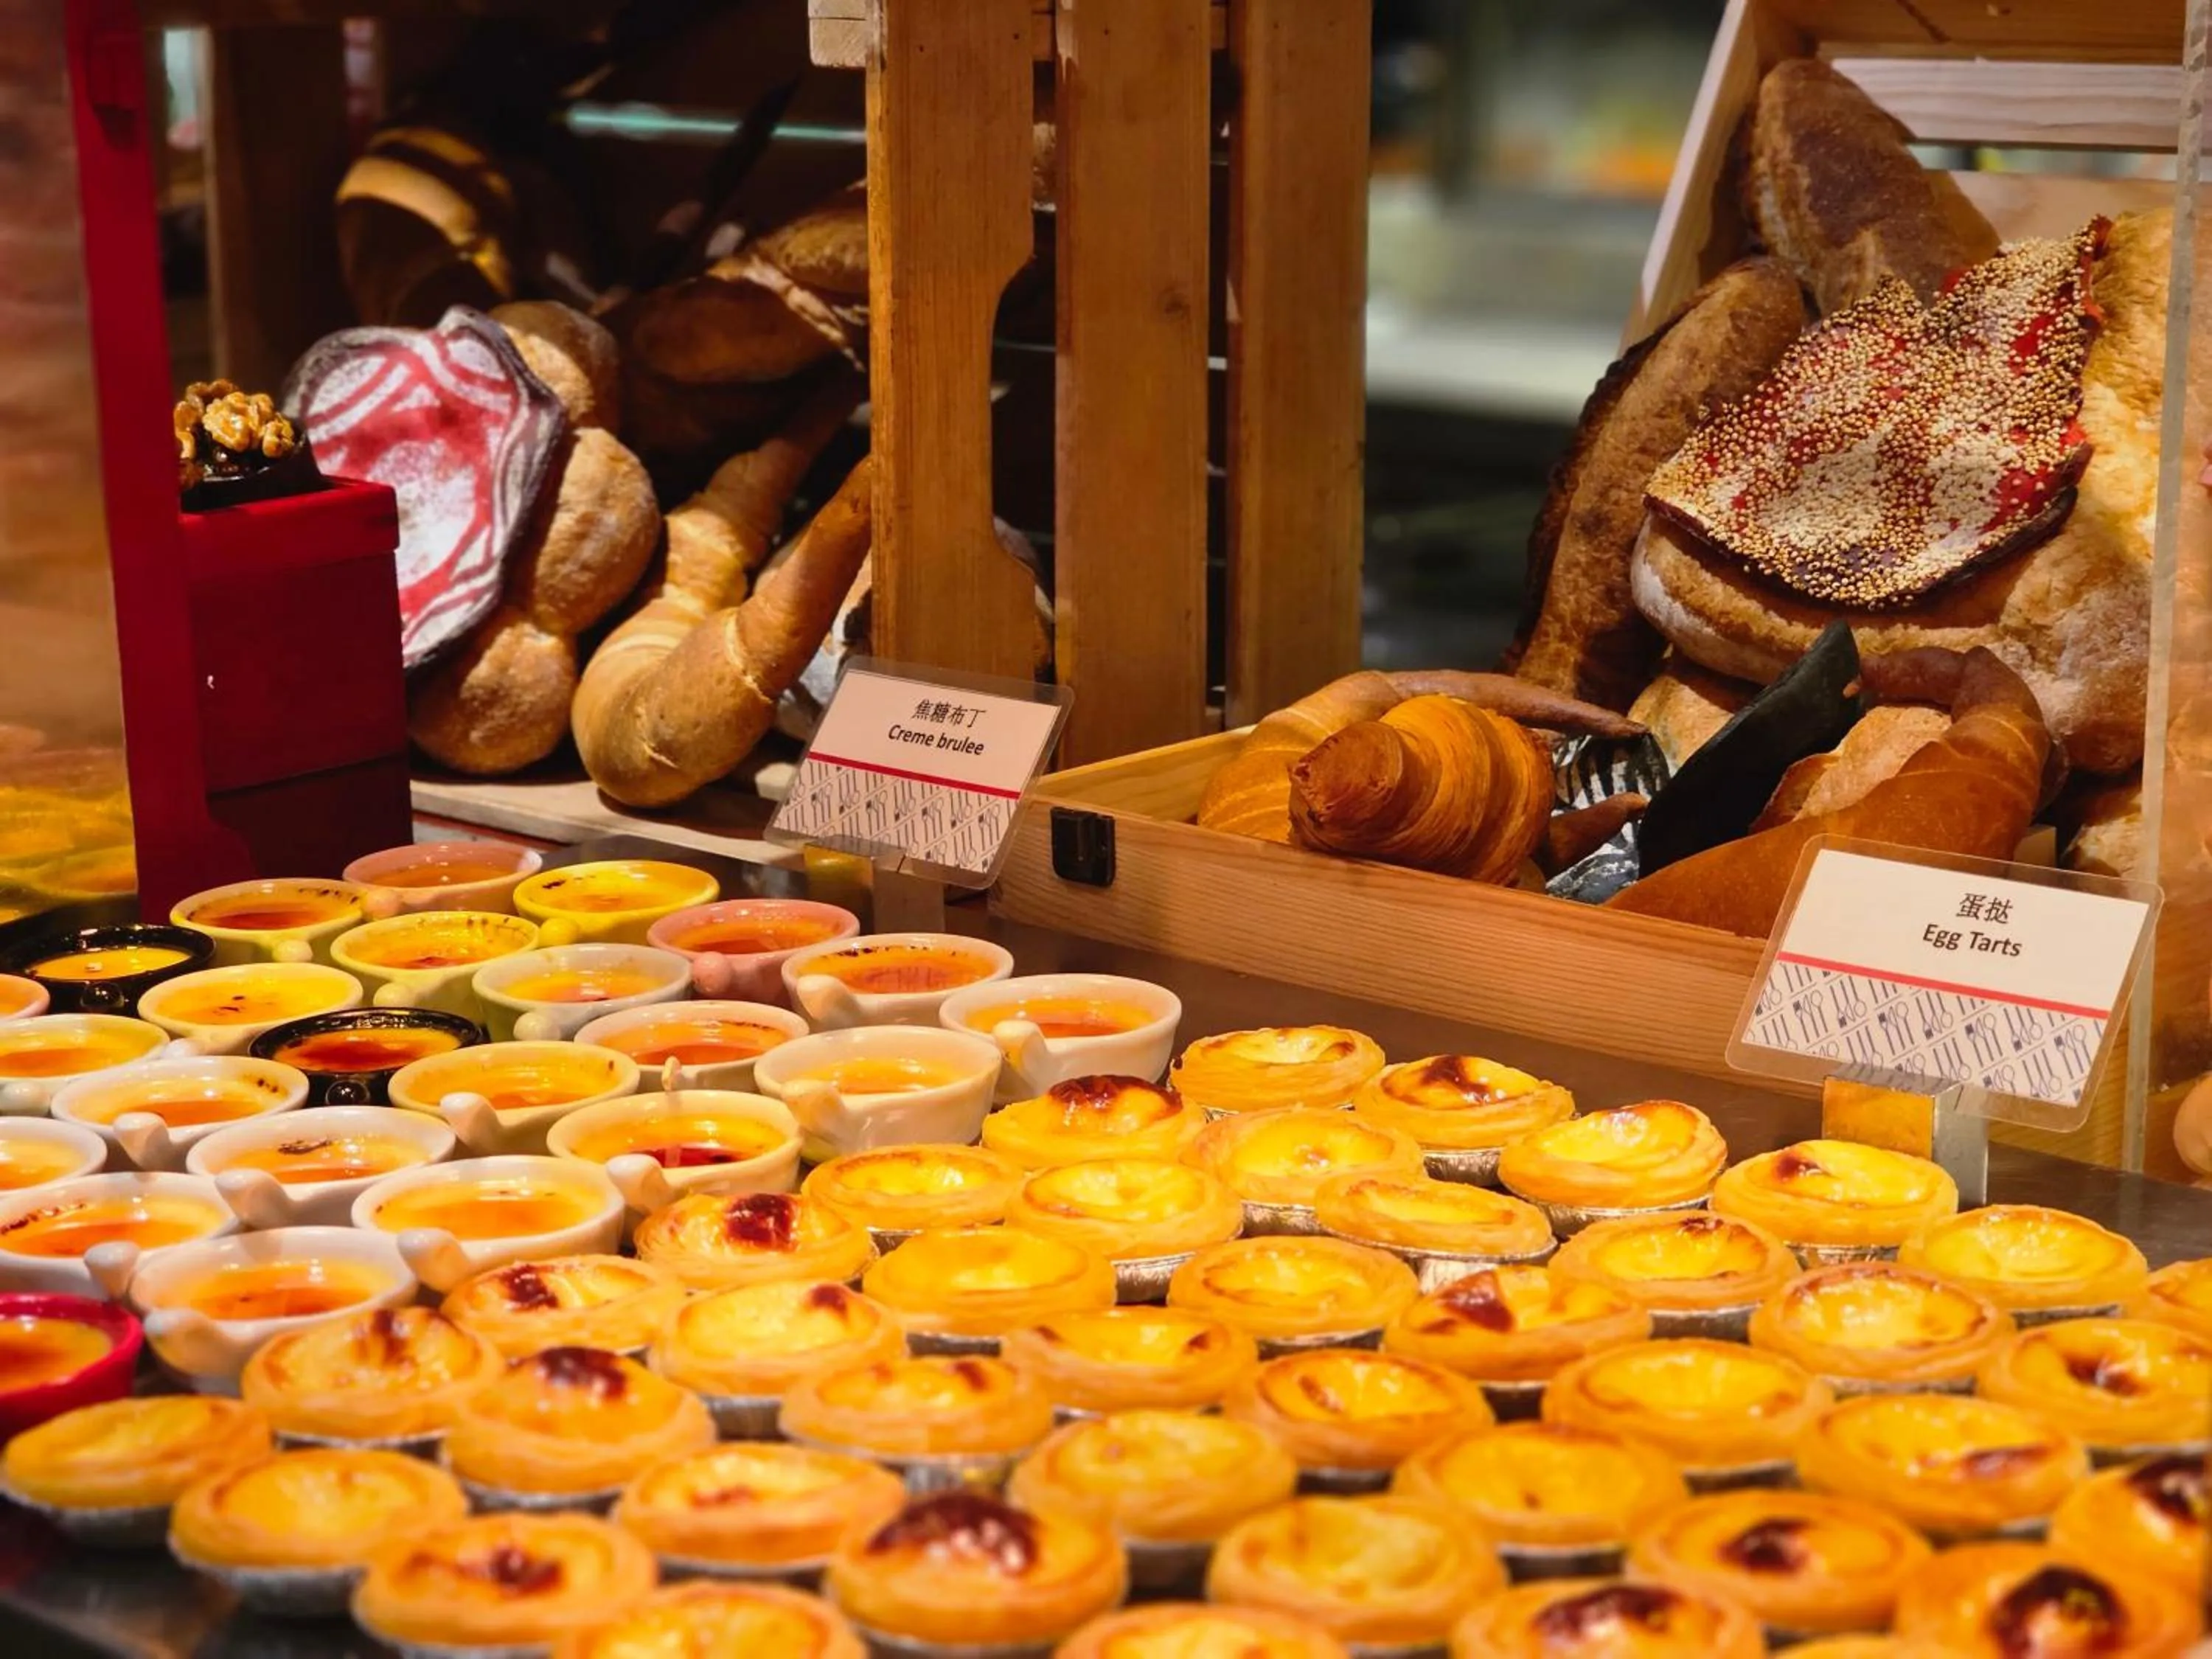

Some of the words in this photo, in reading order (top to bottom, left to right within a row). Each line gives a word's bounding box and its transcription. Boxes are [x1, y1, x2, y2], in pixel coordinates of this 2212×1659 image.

[911, 699, 987, 728] 焦糖布丁
[888, 724, 935, 747] Creme
[936, 732, 984, 756] brulee
[1955, 892, 2013, 924] 蛋挞
[1922, 923, 1963, 950] Egg
[1969, 931, 2023, 957] Tarts
